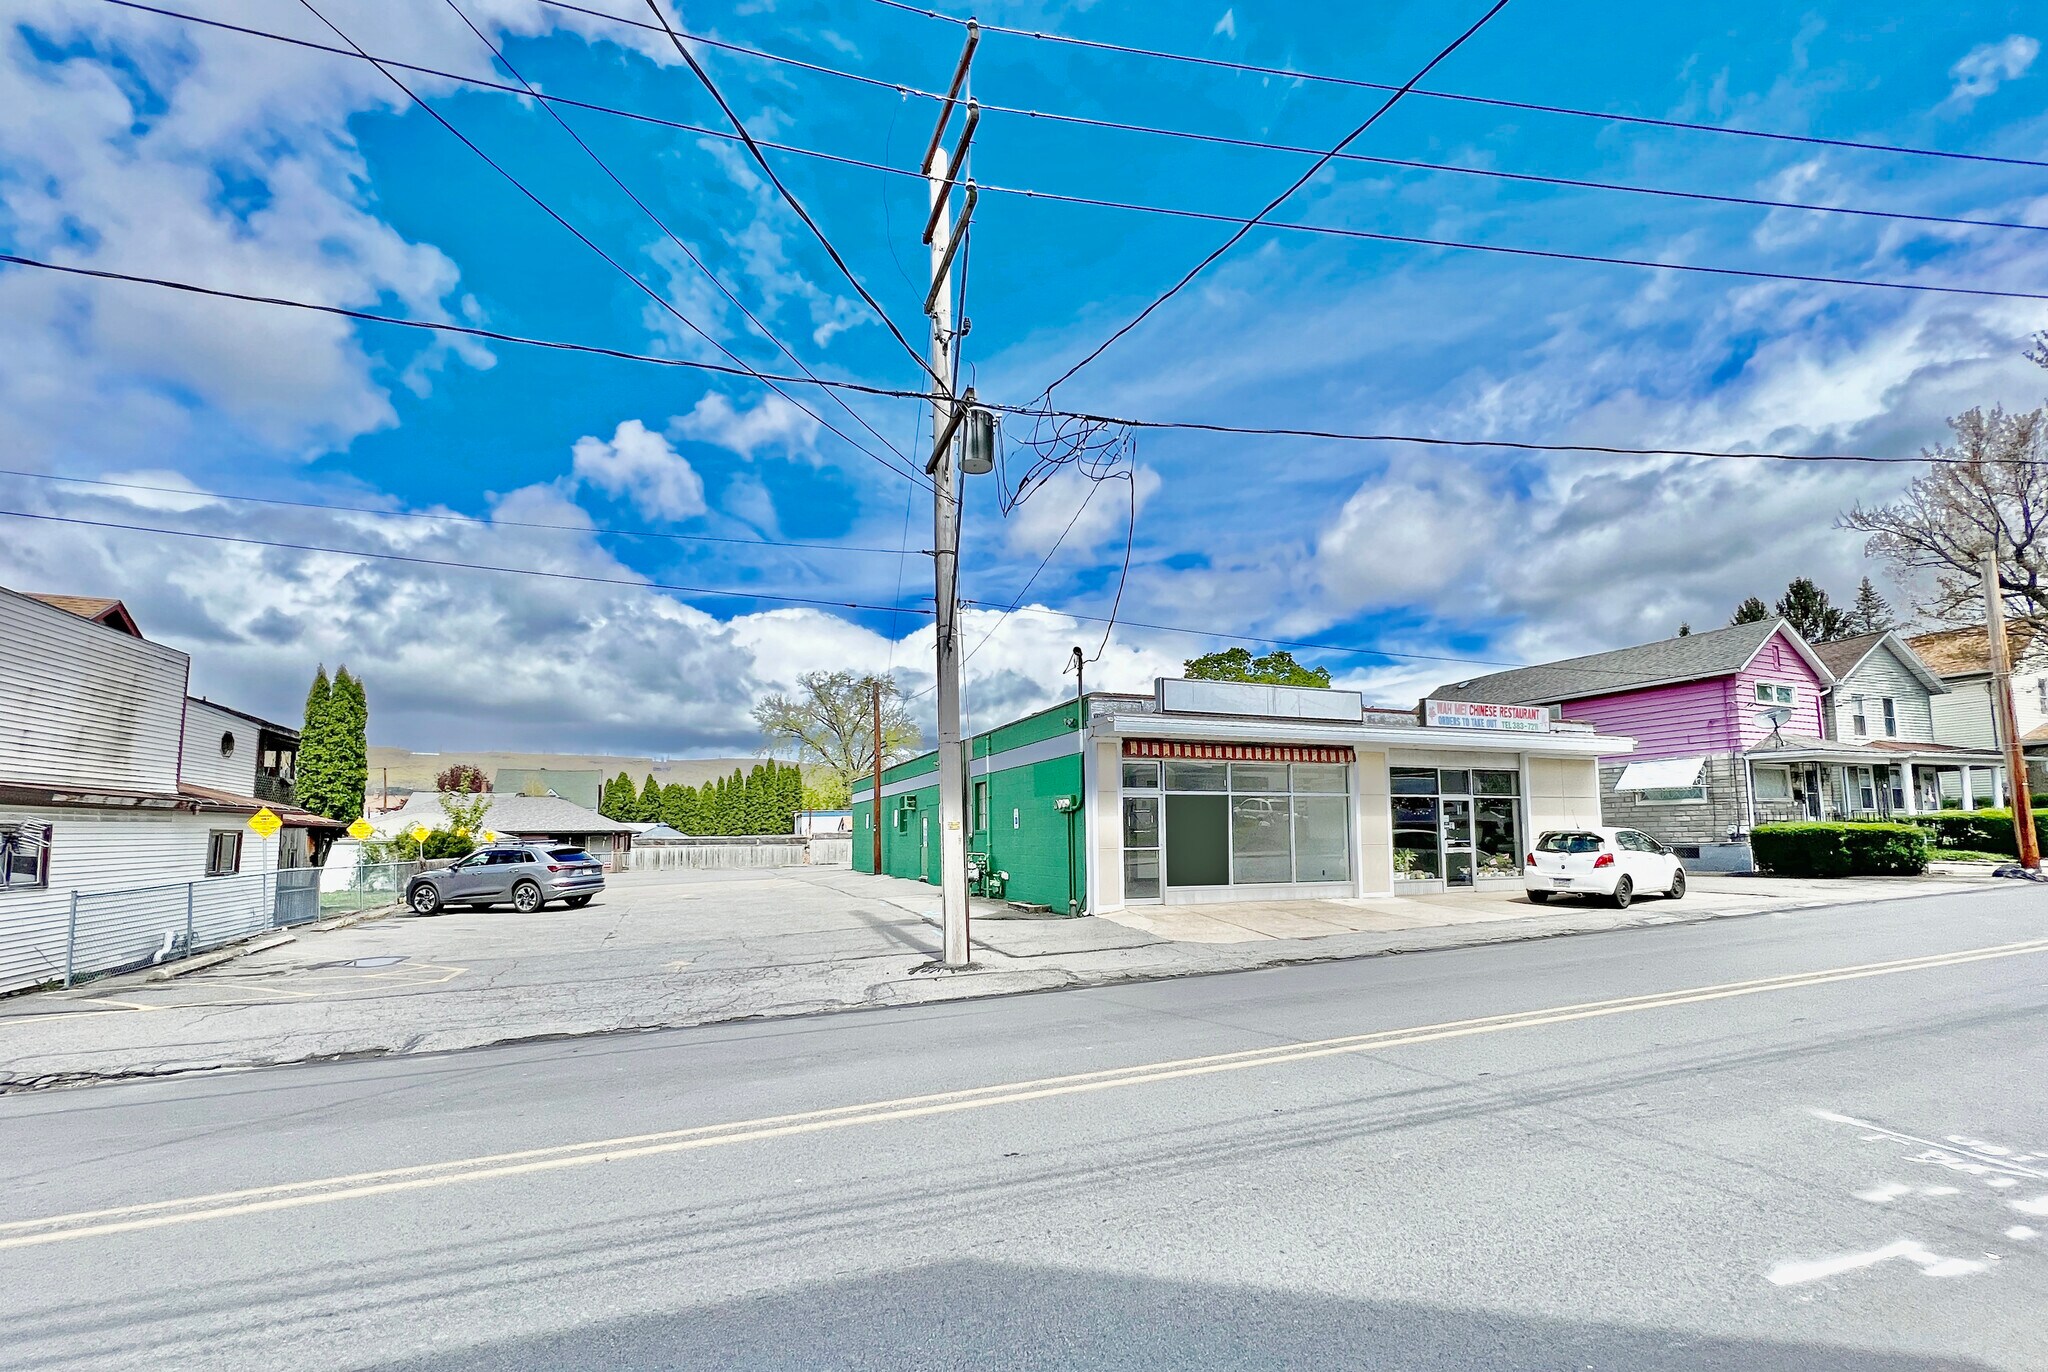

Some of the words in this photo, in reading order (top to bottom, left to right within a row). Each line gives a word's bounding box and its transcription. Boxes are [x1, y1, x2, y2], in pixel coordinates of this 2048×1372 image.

[1469, 704, 1497, 718] CHINESE
[1499, 706, 1539, 720] RESTAURANT
[1438, 716, 1460, 726] ORDERS
[1461, 717, 1470, 727] TO
[1471, 718, 1485, 728] TAKE
[1486, 719, 1497, 729] OUT
[1501, 720, 1511, 729] TEL
